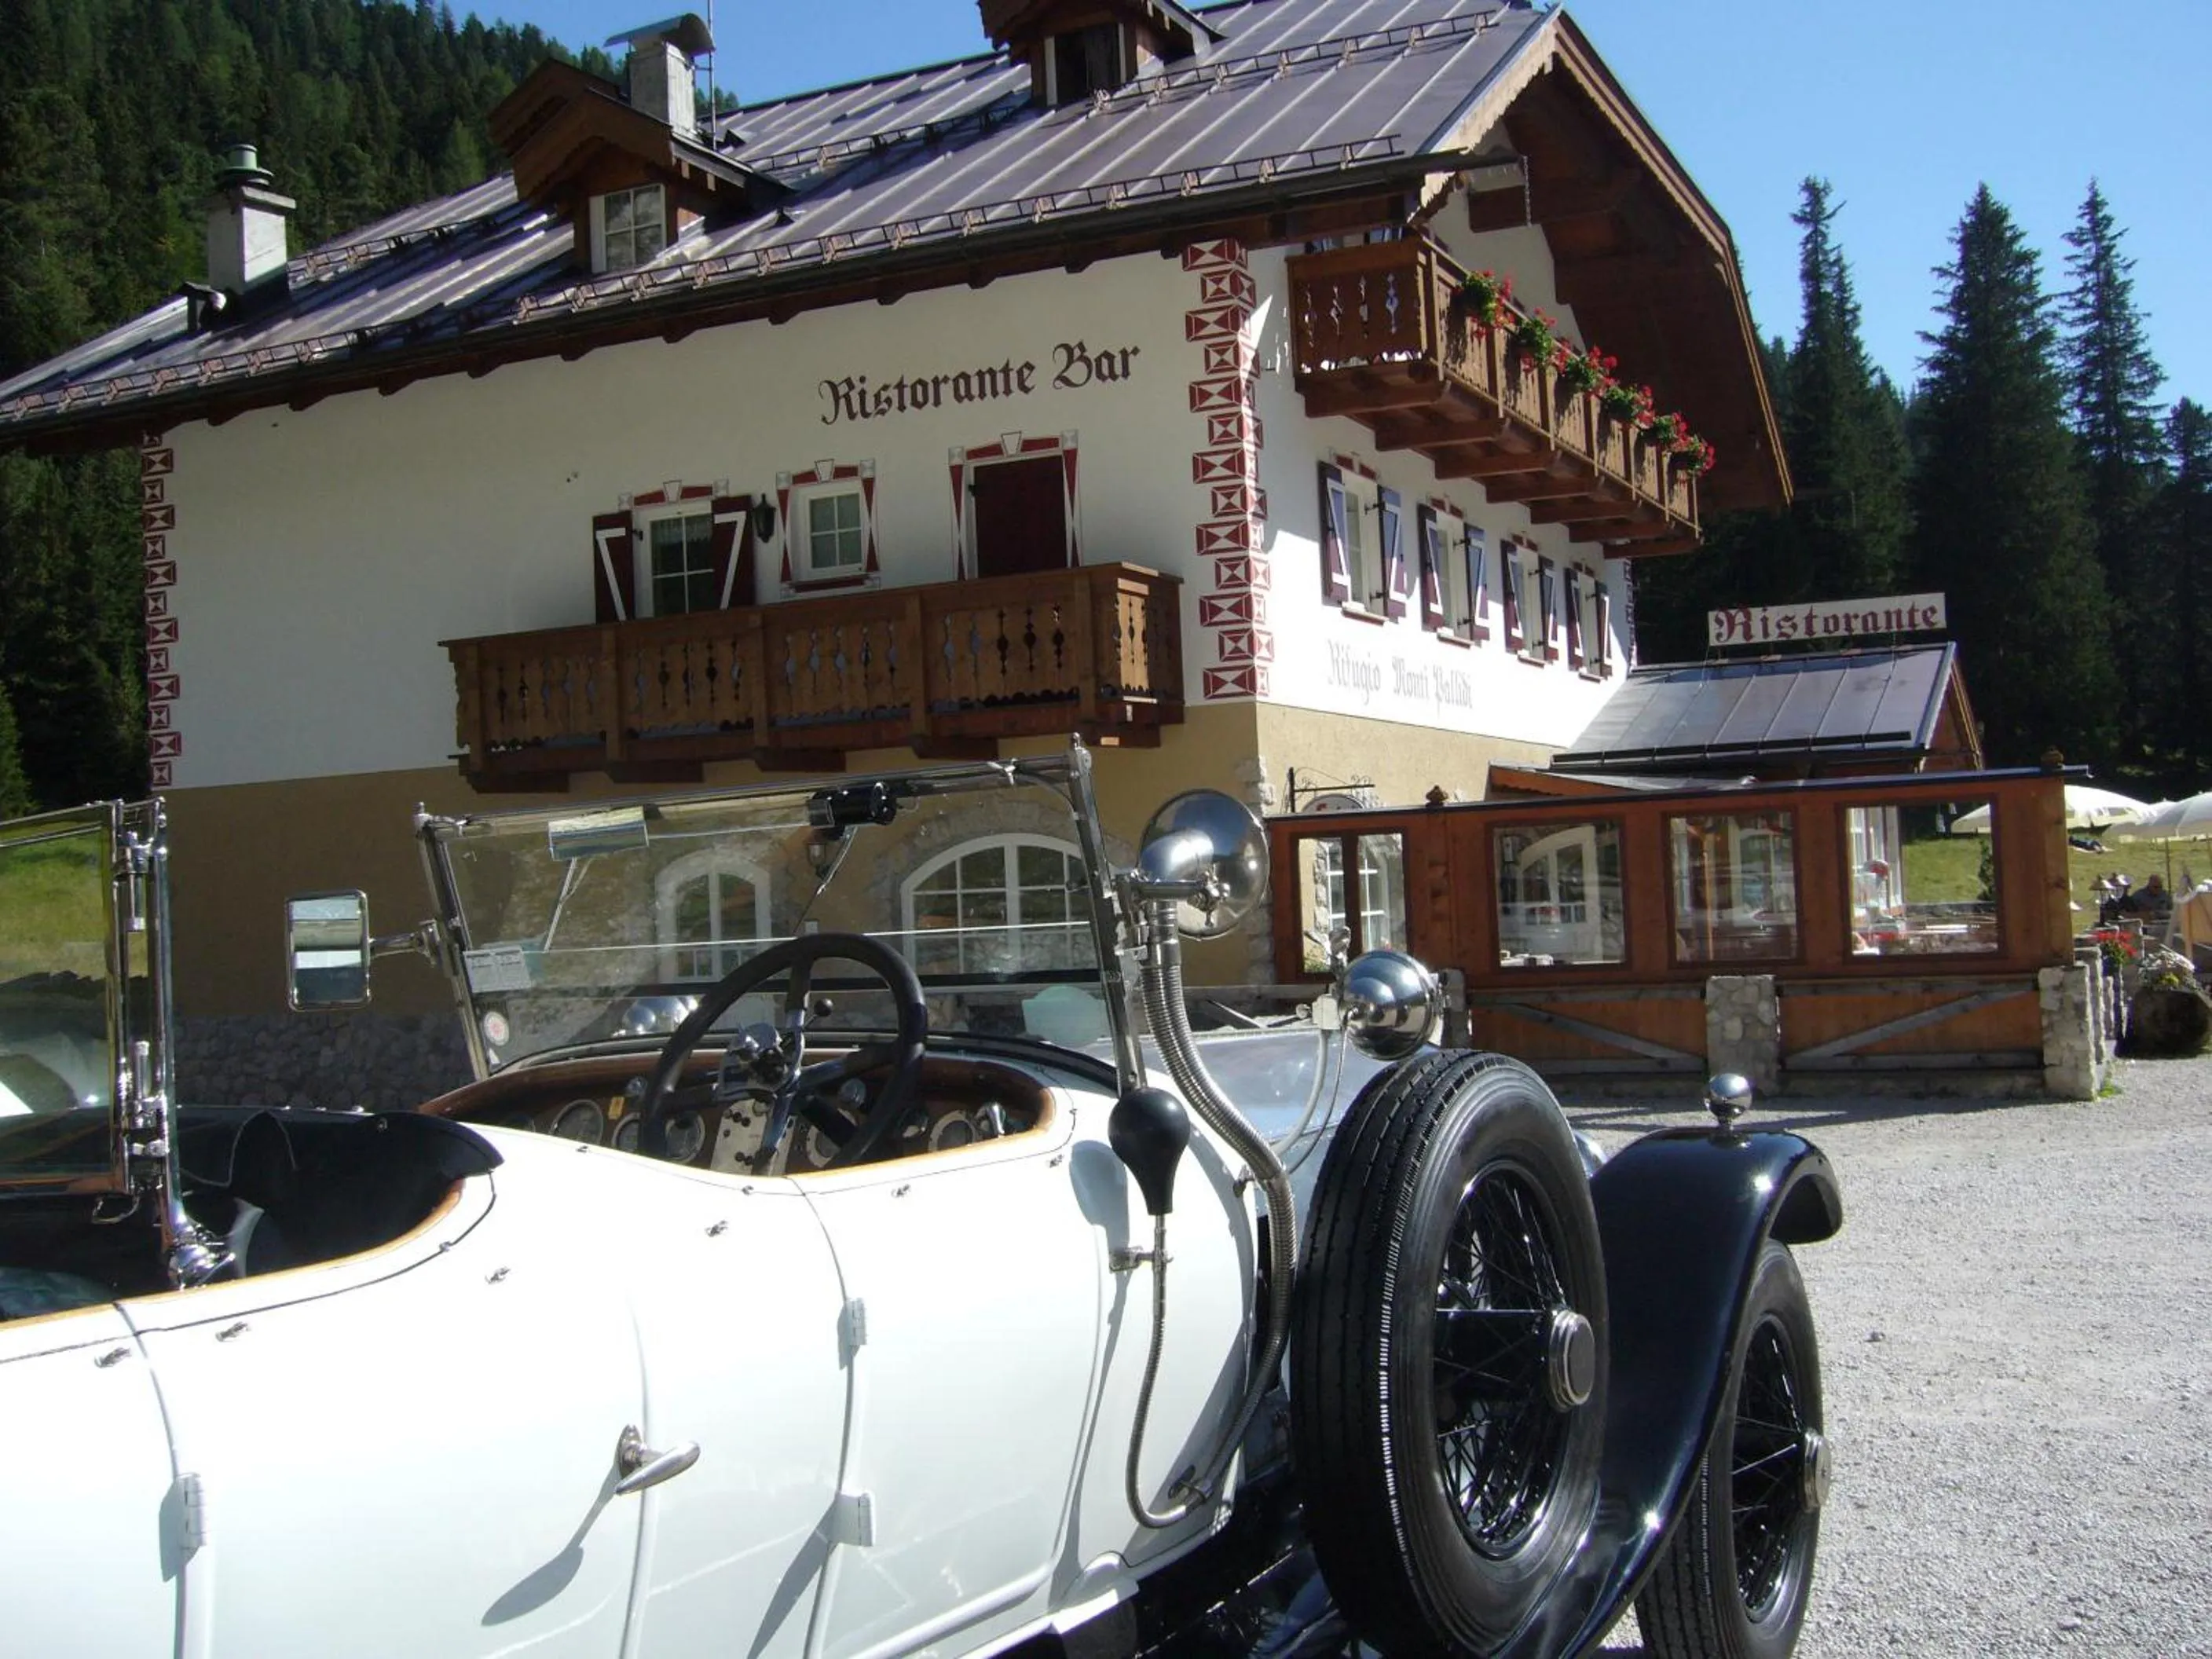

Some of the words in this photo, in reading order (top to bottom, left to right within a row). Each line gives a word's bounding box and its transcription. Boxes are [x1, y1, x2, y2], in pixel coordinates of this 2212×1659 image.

[819, 358, 1035, 425] Ristorante
[1053, 339, 1141, 390] Bar
[1714, 602, 1938, 643] Ristorante
[1327, 639, 1381, 706] Rifugio
